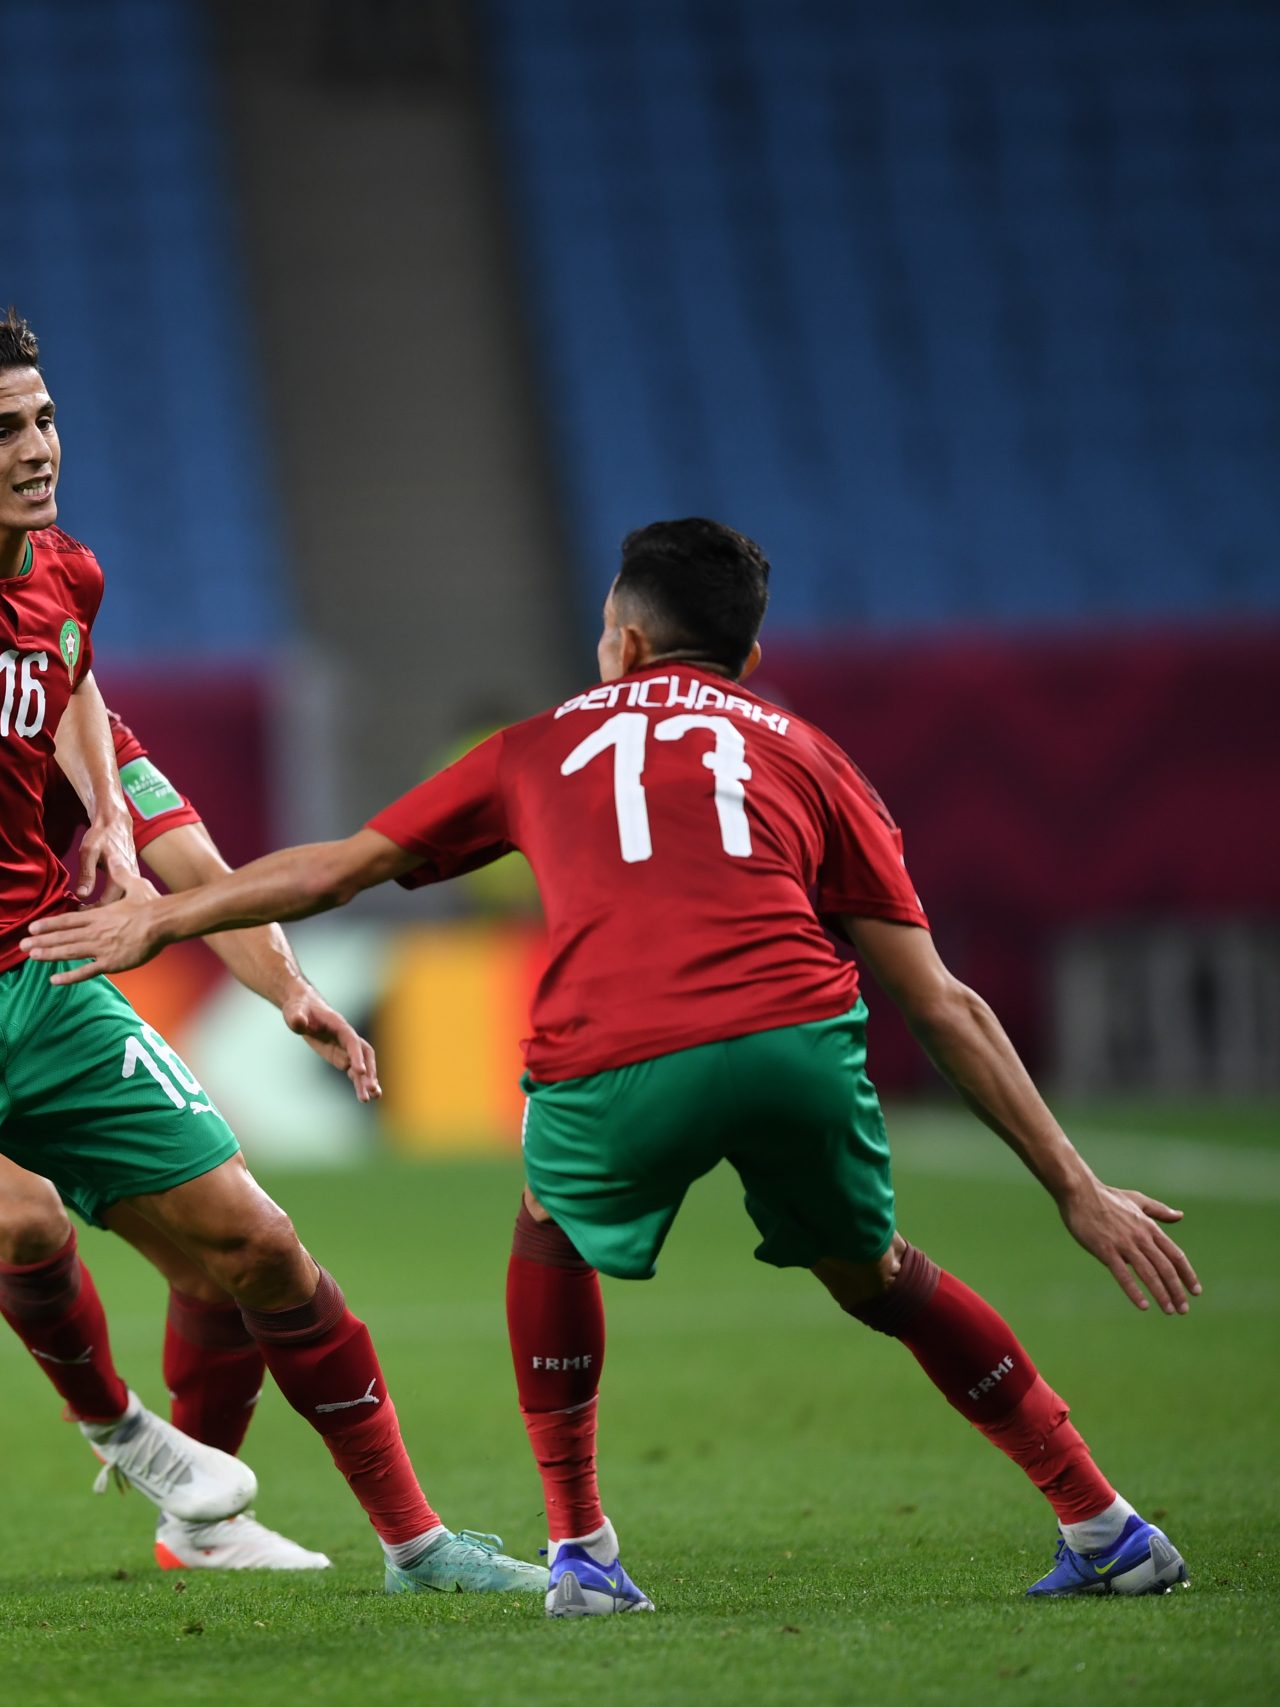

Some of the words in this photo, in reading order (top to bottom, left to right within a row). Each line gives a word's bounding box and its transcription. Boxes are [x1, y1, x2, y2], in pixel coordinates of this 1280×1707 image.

[553, 675, 790, 736] BENCHARKI
[560, 712, 752, 863] 17
[532, 1354, 592, 1371] FRMF
[968, 1355, 1014, 1400] FRMF
